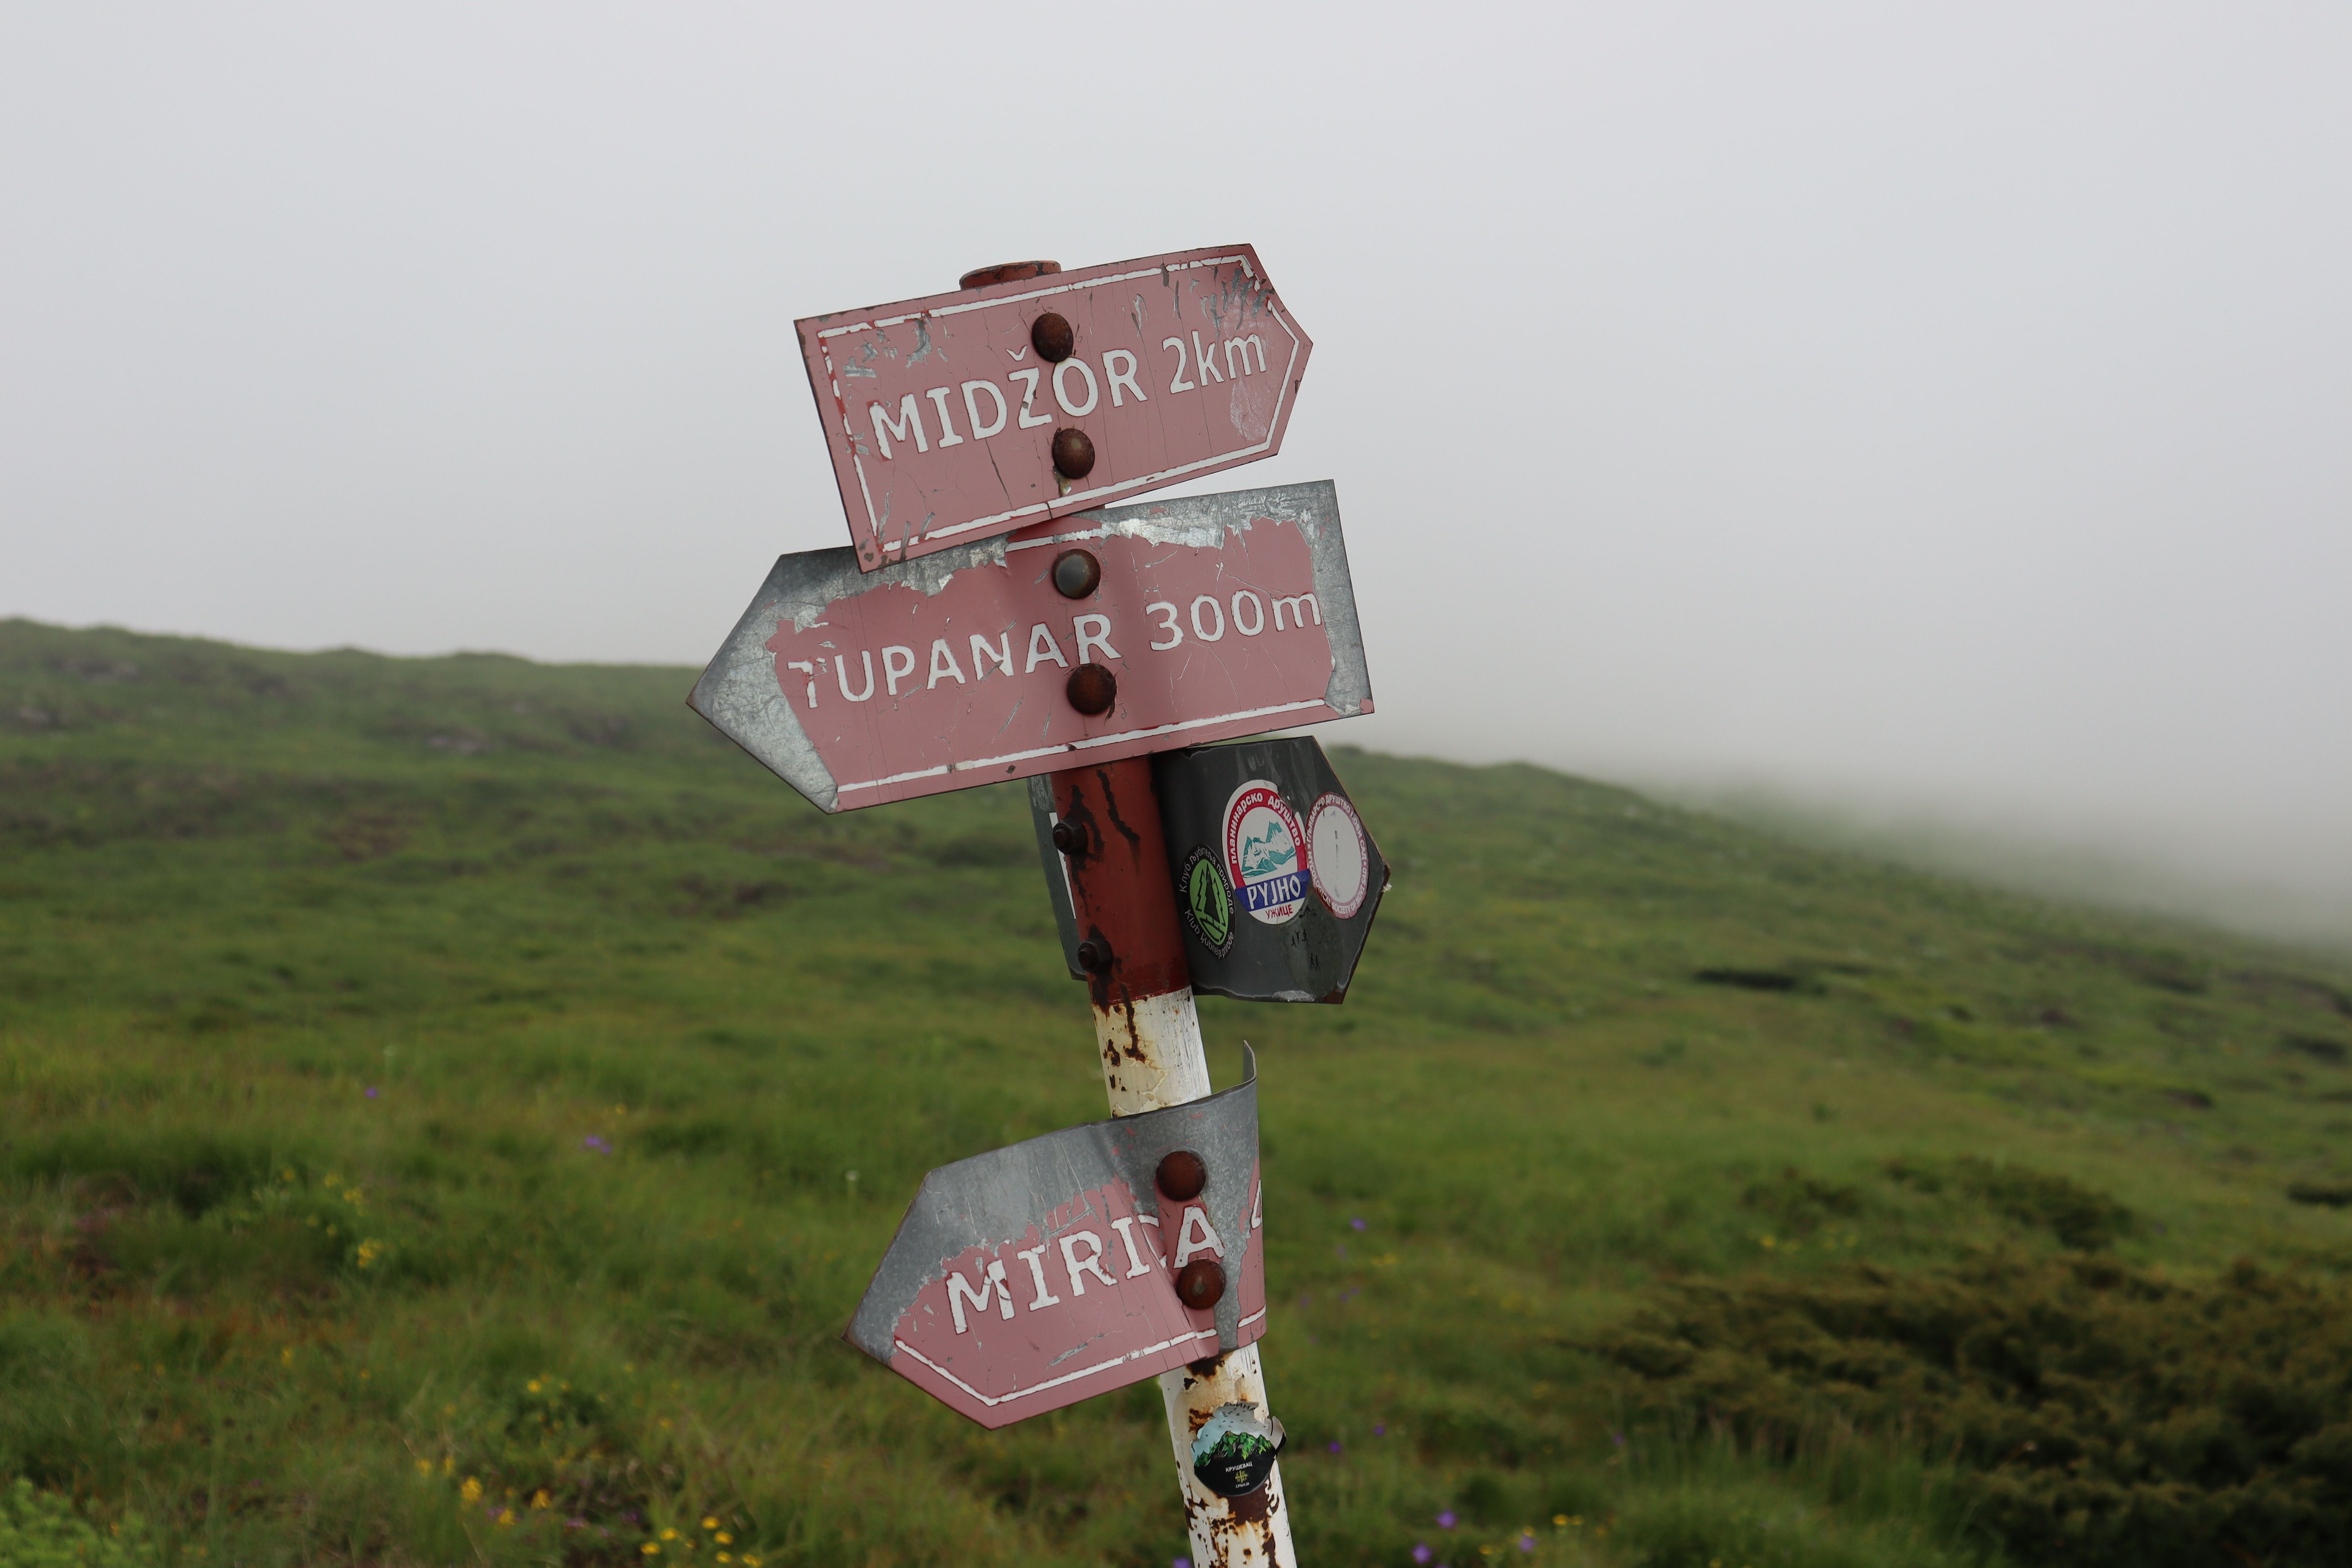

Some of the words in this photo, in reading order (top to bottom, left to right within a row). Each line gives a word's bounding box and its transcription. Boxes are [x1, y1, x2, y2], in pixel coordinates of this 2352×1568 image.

[869, 346, 1148, 459] MIDŽOR
[1163, 330, 1267, 394] 2km
[787, 614, 1122, 709] TUPANAR
[1146, 590, 1323, 651] 300m
[1325, 794, 1350, 814] ДРУШТВО
[1180, 862, 1191, 893] Клуб
[1216, 864, 1234, 914] природе
[1246, 875, 1301, 909] РУЈНО
[1307, 851, 1332, 907] MYCOLOGICAL
[1331, 903, 1351, 914] SOCIETY
[1350, 901, 1357, 911] OF
[1355, 884, 1365, 905] NOVI
[1185, 909, 1200, 934] Klub
[1221, 932, 1234, 959] prirode
[1265, 904, 1293, 920] УЖИЦЕ
[1225, 1461, 1253, 1472] КРУШЕВАЦ
